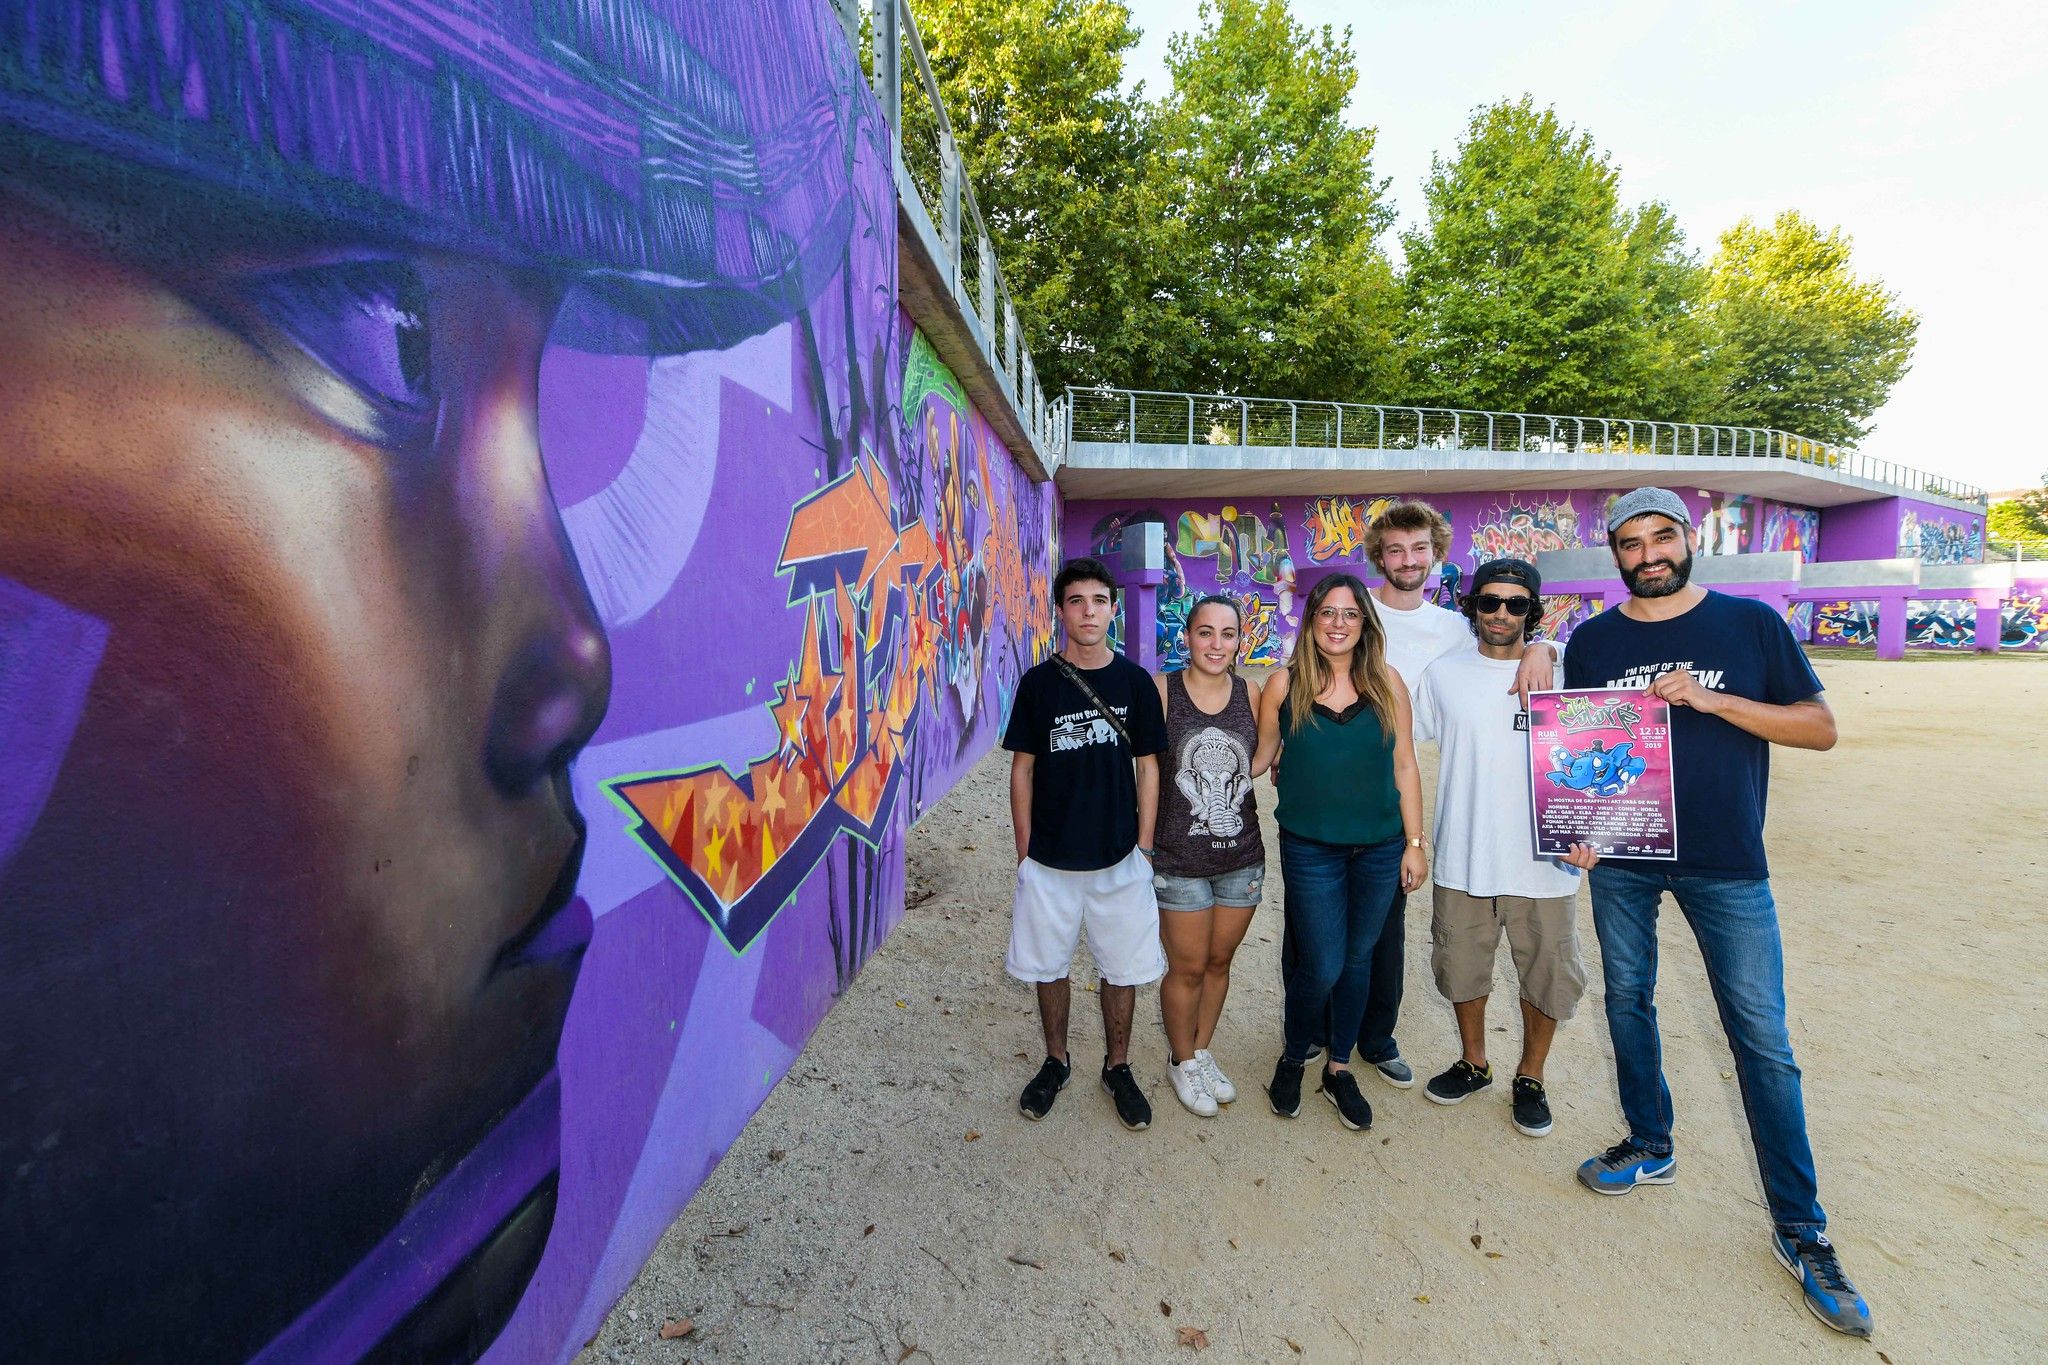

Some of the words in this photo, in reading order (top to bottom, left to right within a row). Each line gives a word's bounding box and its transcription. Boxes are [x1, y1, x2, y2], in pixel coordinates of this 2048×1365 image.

[1625, 667, 1638, 677] I'M
[1639, 663, 1660, 675] PART
[1661, 662, 1674, 671] OF
[1676, 661, 1694, 670] THE
[1538, 728, 1558, 738] RUBÍ
